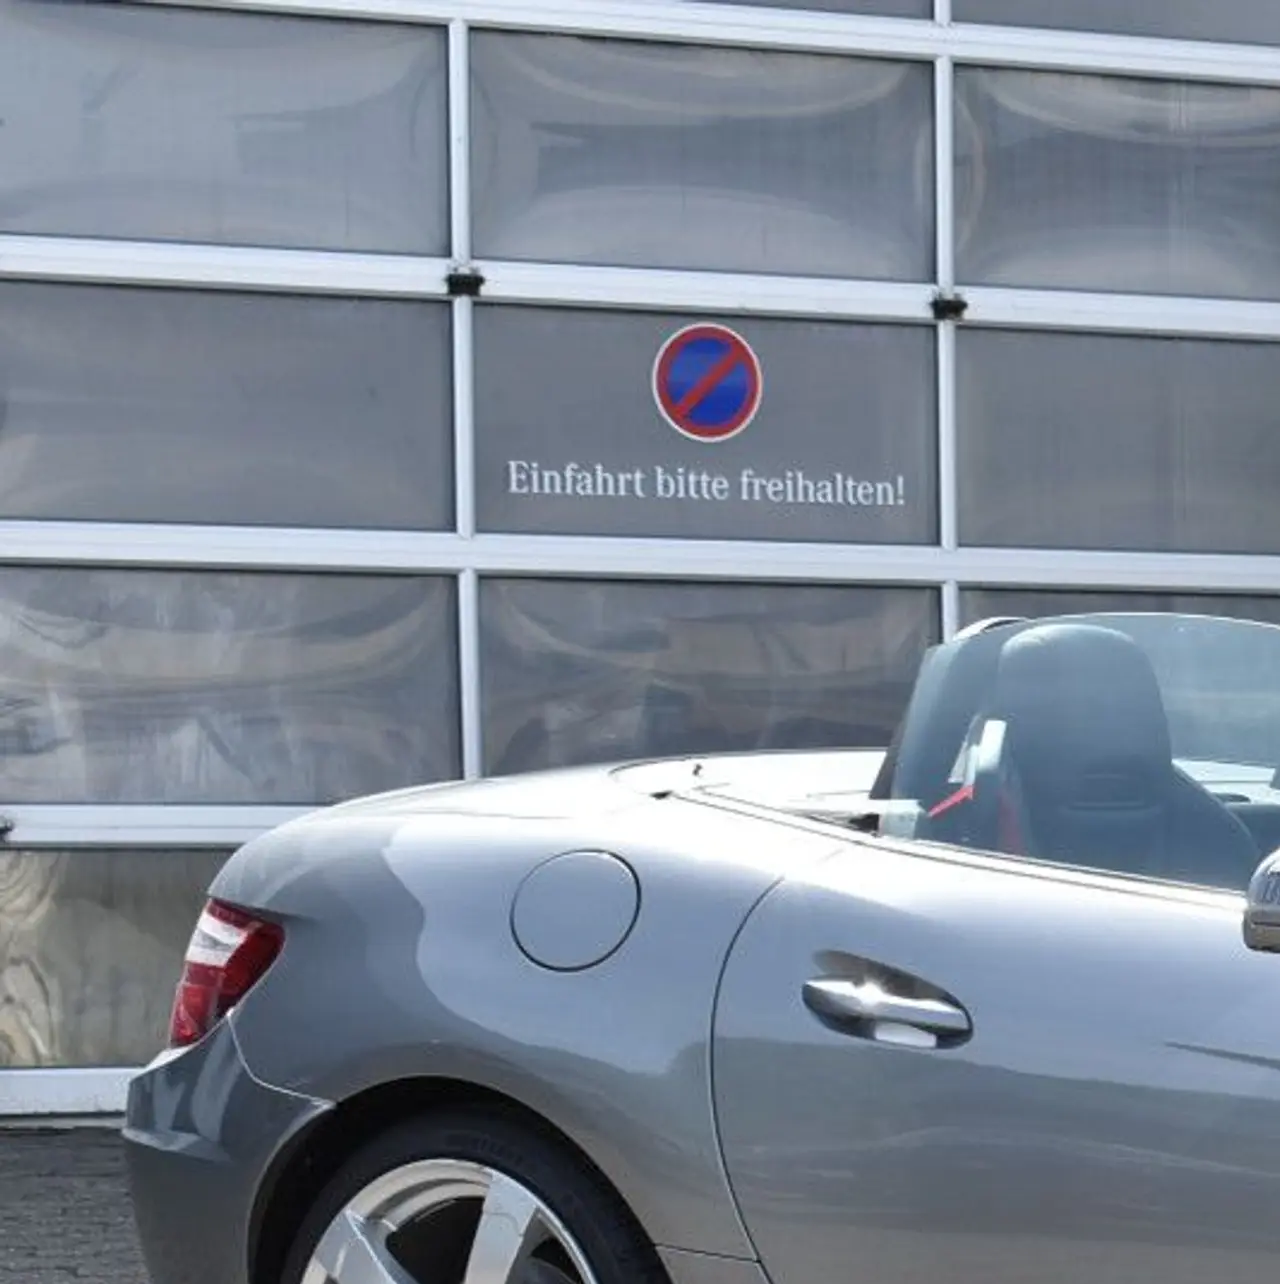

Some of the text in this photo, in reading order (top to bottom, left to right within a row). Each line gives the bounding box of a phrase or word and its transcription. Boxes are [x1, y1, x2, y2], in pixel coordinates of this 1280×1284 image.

[507, 460, 906, 505] Einfahrt bitte freihalten!
